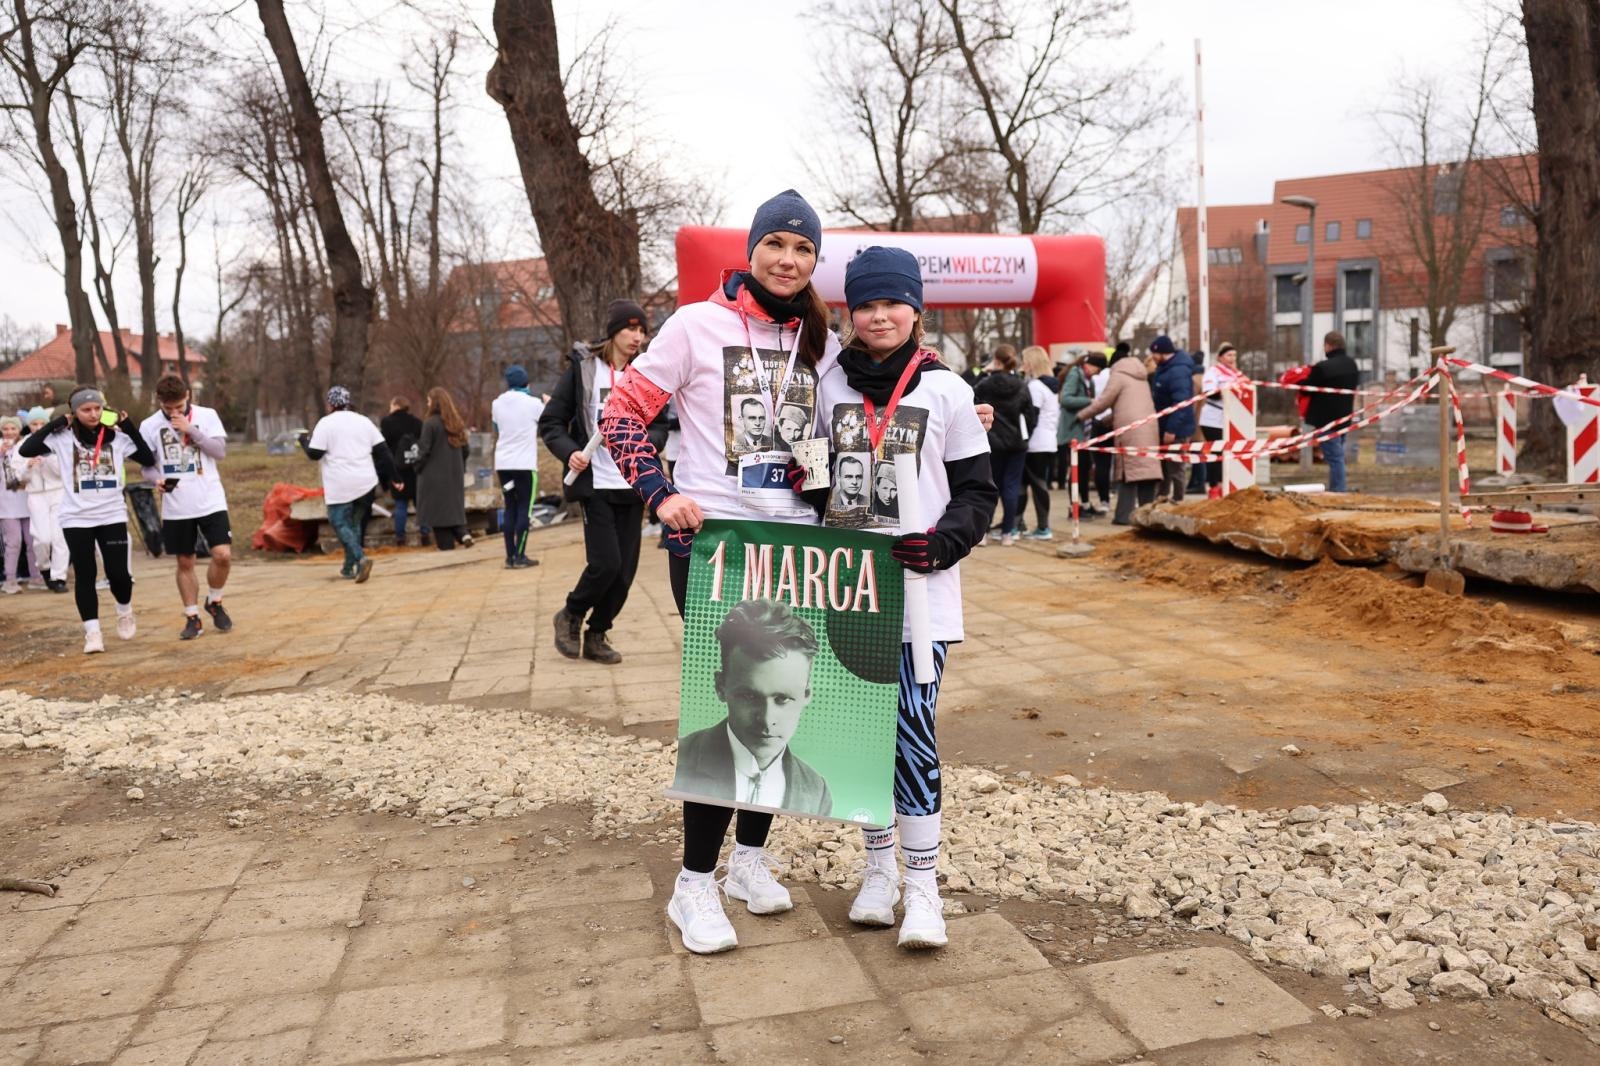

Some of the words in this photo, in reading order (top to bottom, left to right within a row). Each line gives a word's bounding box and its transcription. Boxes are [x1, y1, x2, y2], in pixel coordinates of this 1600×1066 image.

[918, 256, 1026, 274] PEMWILCZYM
[770, 468, 785, 483] 37
[707, 540, 726, 602] 1
[742, 542, 880, 613] MARCA
[866, 832, 893, 841] TOMMY
